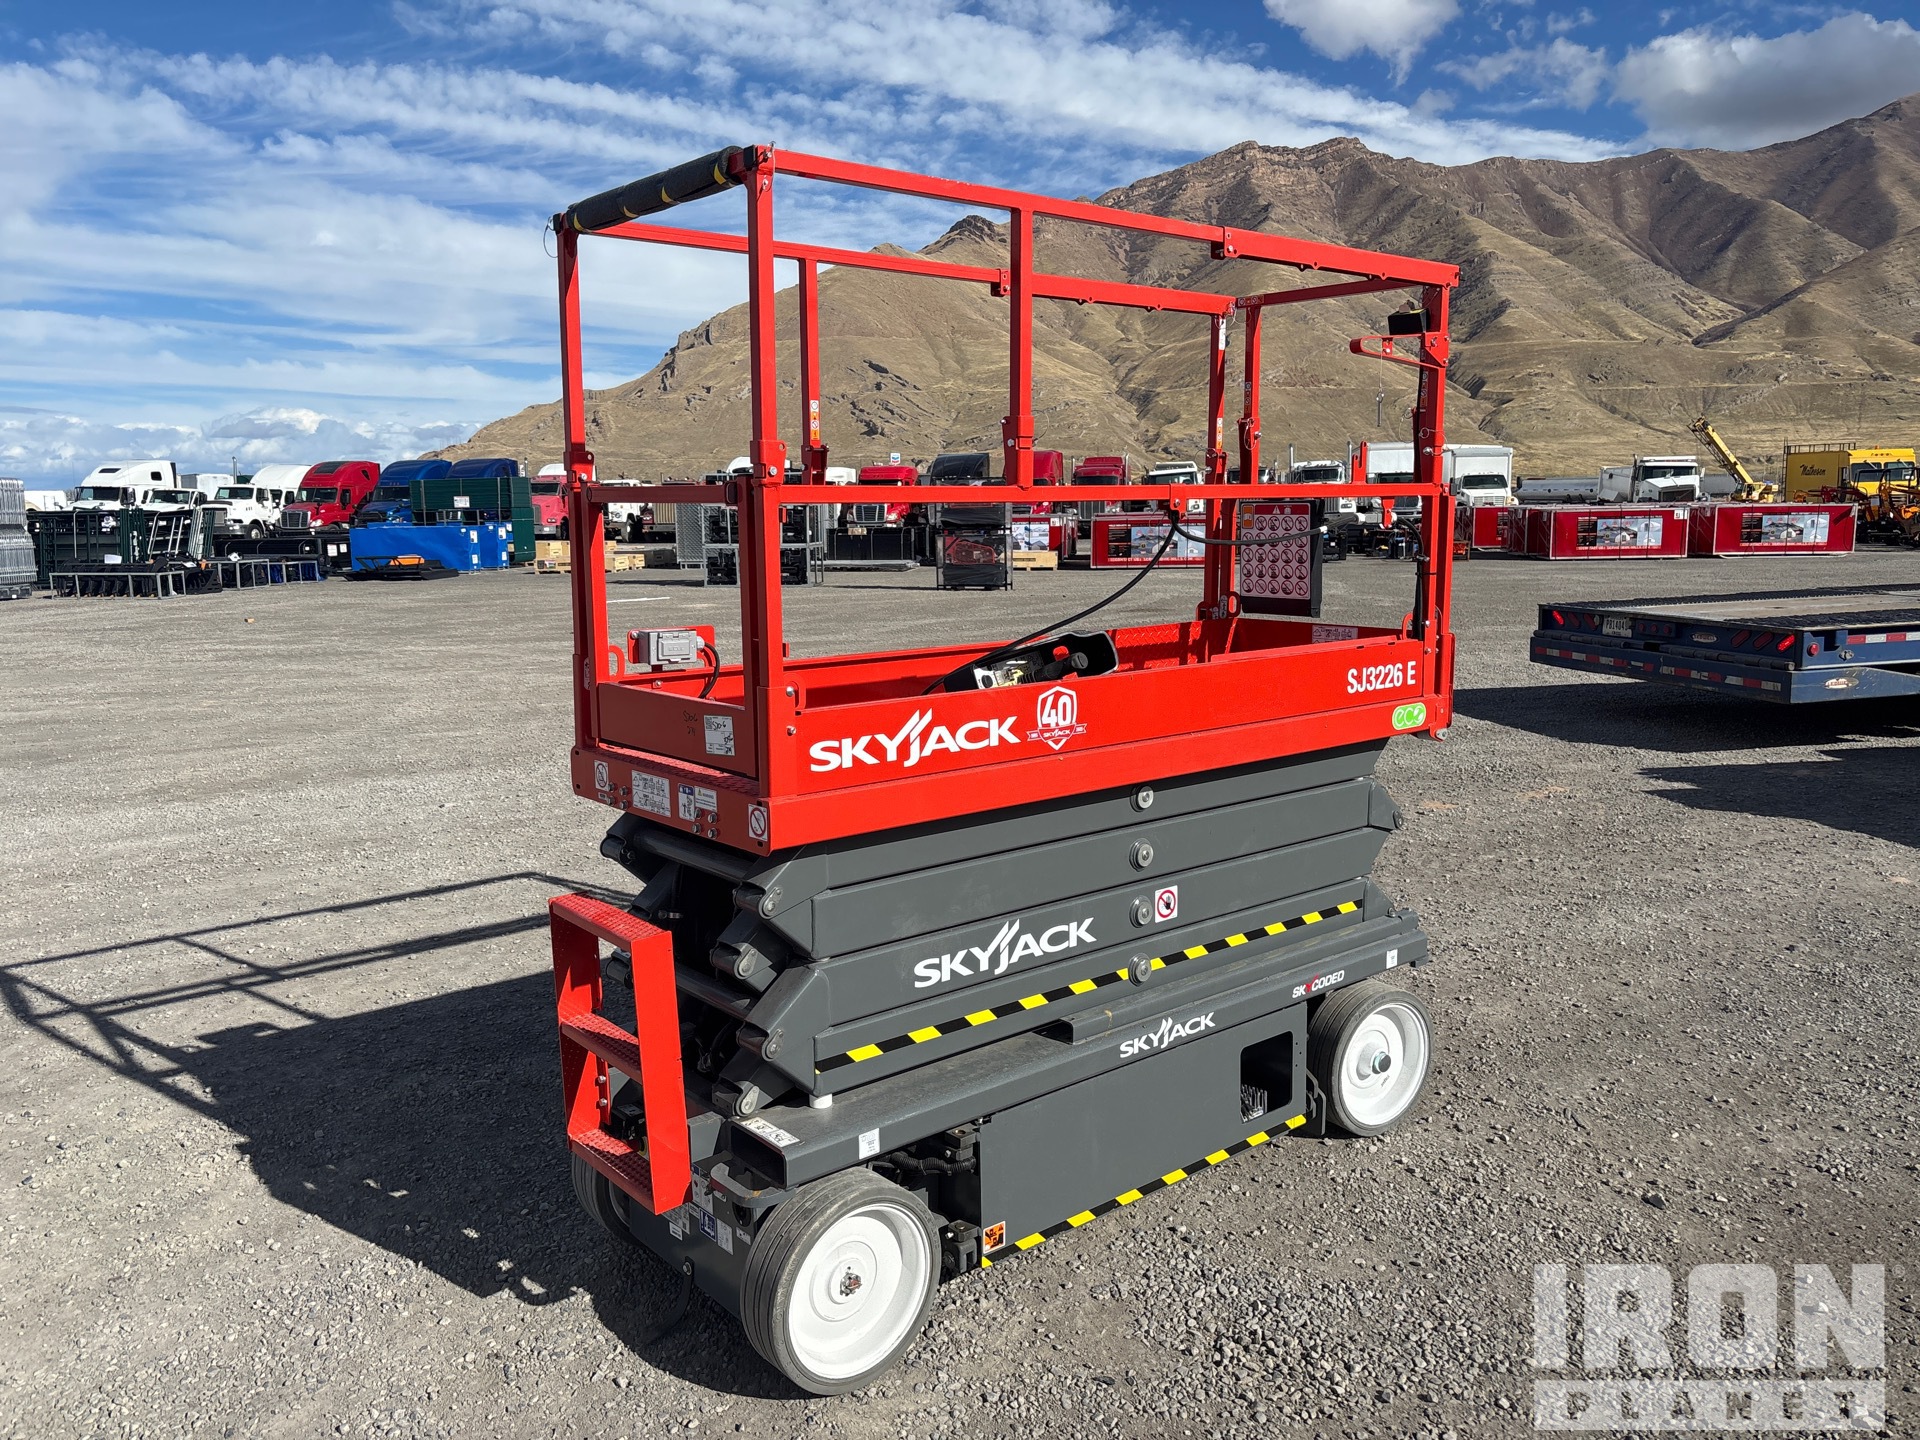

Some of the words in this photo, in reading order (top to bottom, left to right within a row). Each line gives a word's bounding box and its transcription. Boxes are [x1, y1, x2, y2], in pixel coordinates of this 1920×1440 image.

[1346, 663, 1403, 694] SJ3226
[1407, 661, 1416, 685] E
[1041, 694, 1072, 728] 40
[1394, 706, 1425, 728] eco
[809, 708, 1021, 772] SKYJACK
[1042, 728, 1071, 738] SKYJACK
[914, 917, 1097, 989] SKYJACK
[1119, 1012, 1216, 1060] SKYJACK
